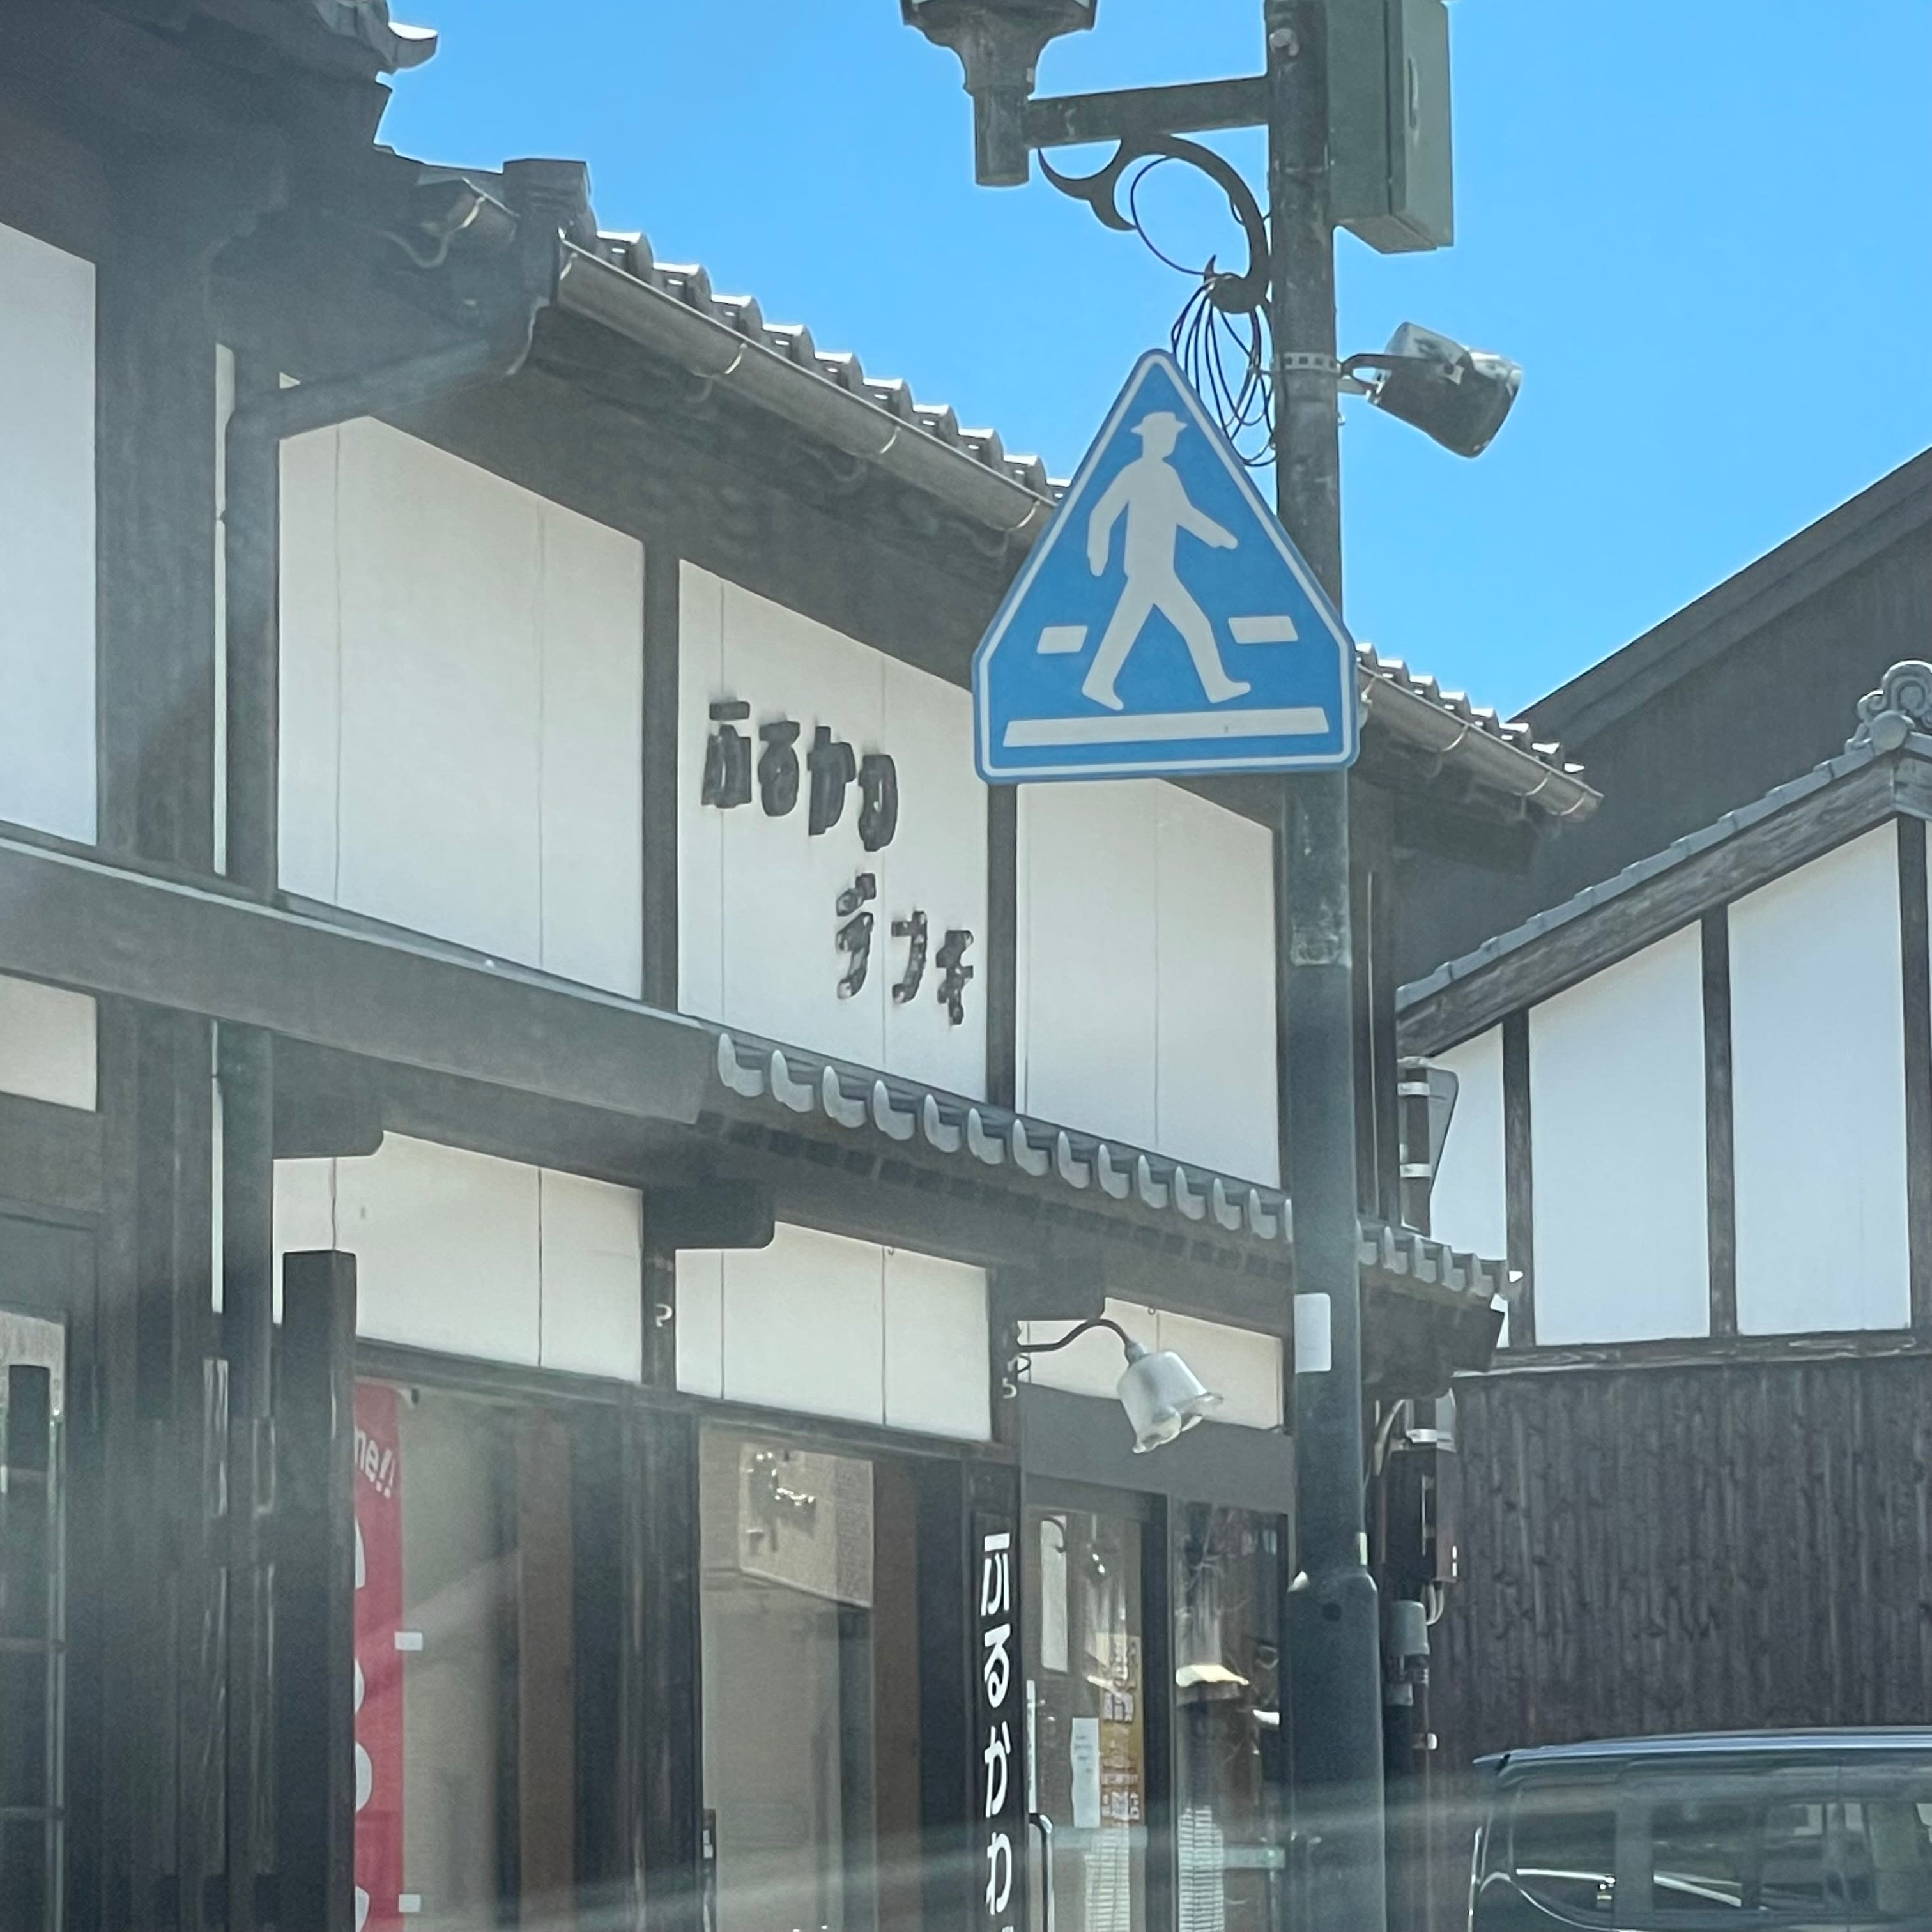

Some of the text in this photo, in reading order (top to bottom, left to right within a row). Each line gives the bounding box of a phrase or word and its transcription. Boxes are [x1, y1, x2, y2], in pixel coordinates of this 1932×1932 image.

[702, 701, 898, 852] ふるかわ
[981, 1533, 1014, 1932] ふるかわ
